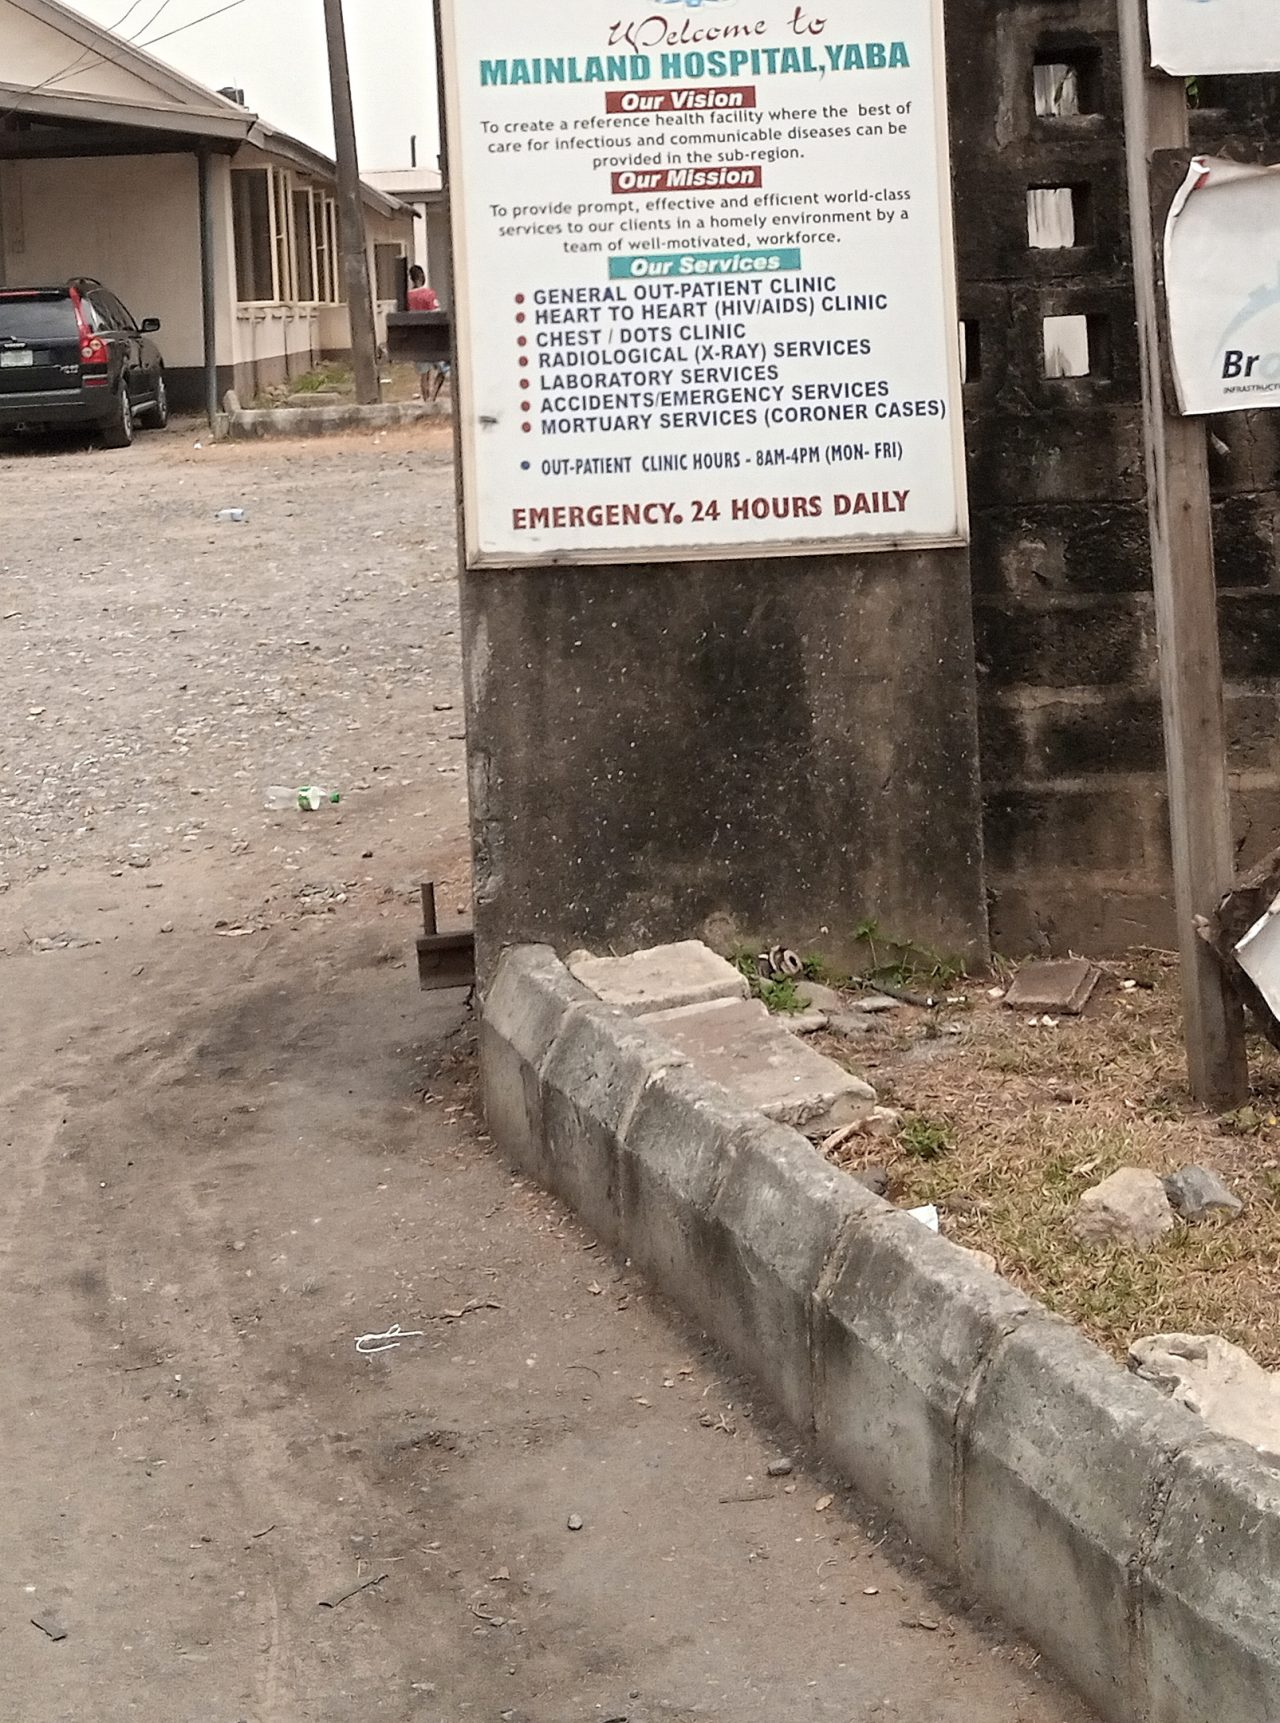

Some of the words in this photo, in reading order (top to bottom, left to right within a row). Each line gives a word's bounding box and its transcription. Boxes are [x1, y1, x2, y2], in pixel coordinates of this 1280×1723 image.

[608, 15, 768, 54] Welcome
[787, 6, 829, 36] to
[479, 55, 652, 86] MAINLAND
[620, 92, 665, 112] Our
[670, 89, 744, 109] Vision
[479, 119, 500, 134] To
[504, 119, 556, 133] create
[559, 120, 569, 131] a
[573, 114, 652, 130] reference
[654, 110, 705, 127] health
[707, 107, 765, 124] facility
[768, 106, 818, 121] where
[822, 103, 850, 118] the
[857, 102, 893, 117] best
[897, 100, 912, 115] of
[488, 142, 522, 152] care
[527, 138, 549, 150] for
[555, 136, 632, 149] infectious
[637, 132, 665, 145] and
[670, 127, 782, 144] communicable
[787, 126, 852, 139] diseases
[856, 125, 883, 136] can
[888, 121, 908, 134] be
[593, 152, 662, 170] provided
[667, 153, 682, 163] in
[686, 151, 713, 163] the
[717, 146, 805, 162] sub-region.
[618, 172, 662, 190] Our
[666, 168, 755, 188] Mission
[491, 205, 506, 216] To
[512, 202, 572, 218] provide
[577, 200, 640, 216] prompt,
[645, 197, 715, 210] effective
[720, 194, 749, 207] and
[753, 192, 820, 206] efficient
[824, 188, 911, 203] world-class
[499, 224, 562, 236] services
[568, 223, 582, 233] to
[588, 222, 614, 232] our
[620, 218, 671, 231] clients
[676, 217, 691, 228] in
[696, 218, 705, 228] a
[710, 213, 767, 228] homely
[771, 210, 872, 225] environment
[876, 208, 895, 223] by
[900, 209, 909, 219] a
[562, 240, 603, 253] team
[608, 239, 622, 250] of
[756, 229, 842, 246] workforce.
[630, 256, 675, 276] Our
[679, 253, 781, 275] Services
[533, 286, 627, 304] GENERAL
[633, 278, 763, 300] OUT-PATIENT
[769, 276, 837, 294] CLINIC
[535, 306, 602, 324] HEART
[607, 305, 634, 321] TO
[641, 301, 708, 319] HEART
[714, 296, 815, 320] (HIV/AIDS)
[821, 293, 888, 311] CLINIC
[536, 329, 602, 347] CHEST
[620, 326, 672, 343] DOTS
[679, 323, 746, 340] CLINIC
[538, 346, 688, 368] RADIOLOGICAL
[694, 342, 767, 364] (X-RAY)
[773, 338, 871, 357] SERVICES
[540, 369, 674, 390] LABORATORY
[680, 364, 779, 384] SERVICES
[540, 385, 785, 413] ACCIDENTS/EMERGENCY
[791, 380, 889, 400] SERVICES
[541, 413, 653, 434] MORTUARY
[659, 408, 757, 428] SERVICES
[764, 403, 869, 428] (CORONER
[874, 399, 946, 419] CASES)
[541, 456, 632, 475] OUT-PATIENT
[641, 453, 688, 472] CLINIC
[692, 451, 741, 469] HOURS
[756, 445, 820, 466] 8AM-4PM
[874, 441, 903, 461] FRI)
[690, 499, 721, 522] 24
[731, 495, 823, 520] HOURS
[833, 489, 911, 516] DAILY
